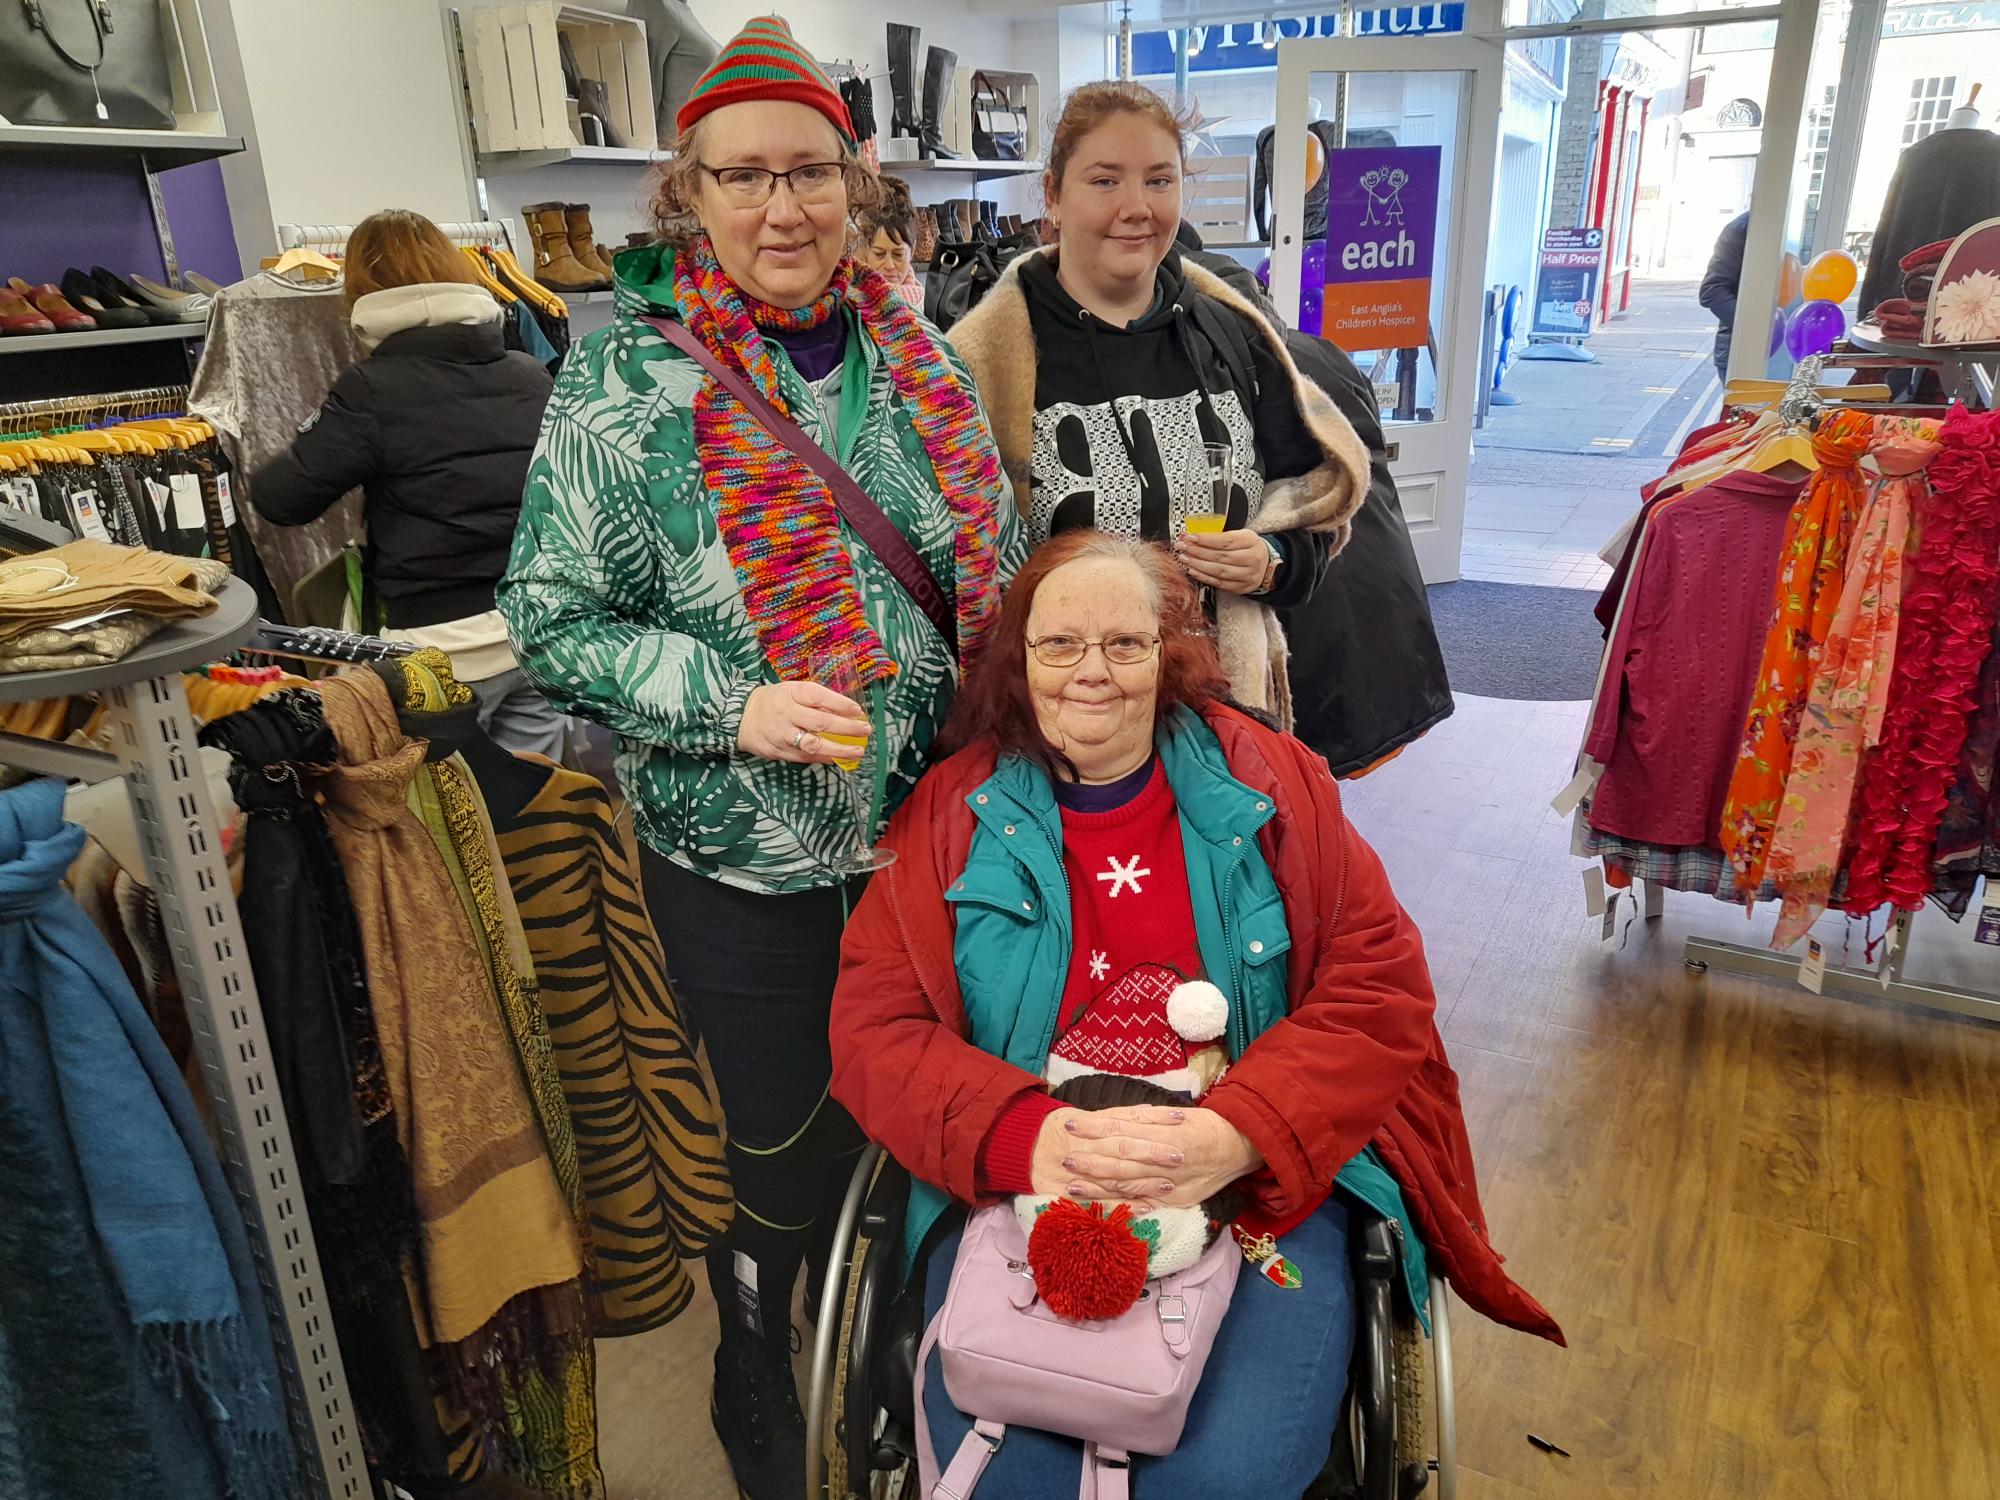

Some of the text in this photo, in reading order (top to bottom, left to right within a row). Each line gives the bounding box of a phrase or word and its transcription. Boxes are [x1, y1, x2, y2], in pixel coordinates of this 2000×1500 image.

[1342, 229, 1415, 271] each
[1543, 254, 1599, 264] Half Price
[1351, 300, 1402, 316] East Anglia's
[1575, 306, 1590, 314] £10
[1335, 314, 1416, 330] Children's Hospices
